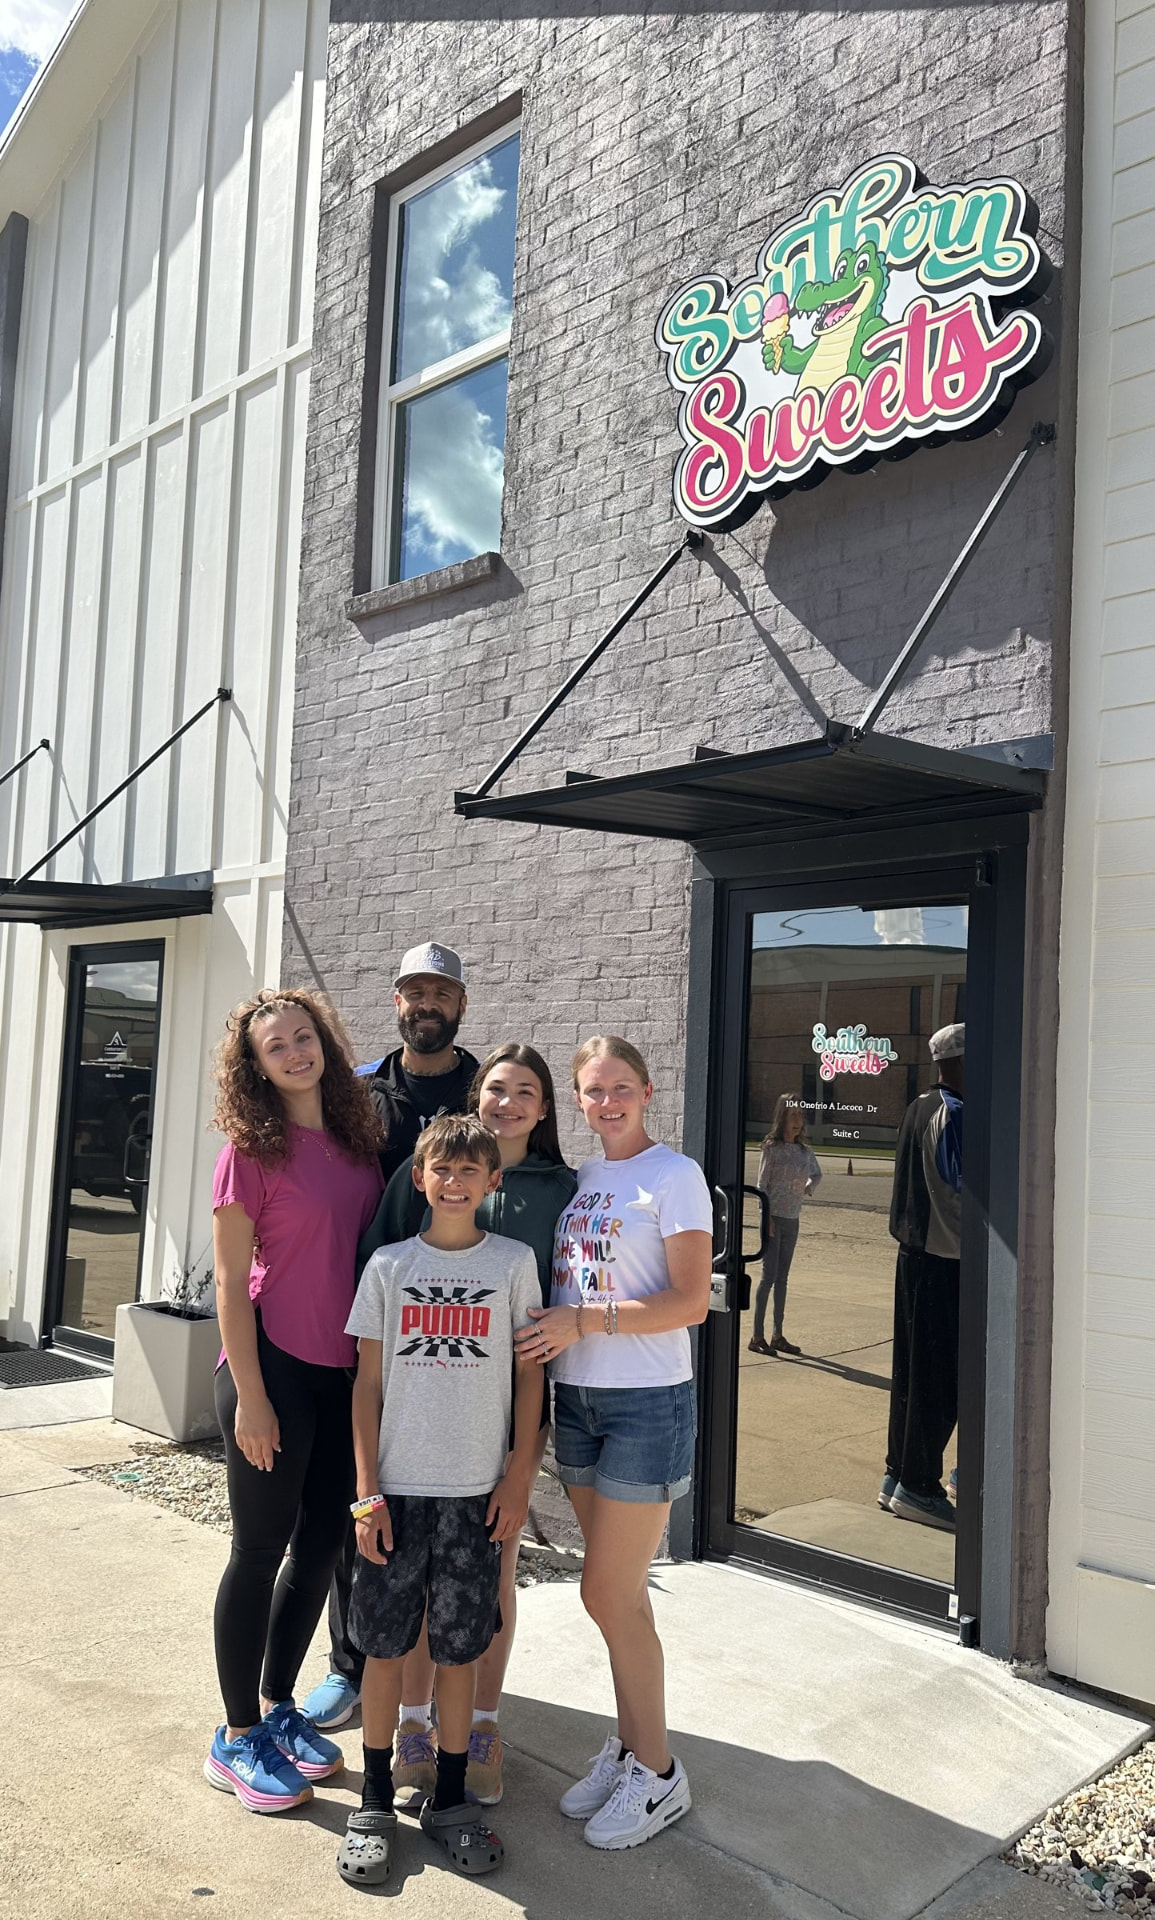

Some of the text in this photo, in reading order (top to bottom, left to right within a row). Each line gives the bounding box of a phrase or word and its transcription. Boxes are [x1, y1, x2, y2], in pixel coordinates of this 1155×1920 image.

[665, 166, 1026, 377] Southern
[683, 300, 1023, 507] Sweets
[812, 1023, 897, 1060] Southern
[820, 1052, 888, 1080] Sweets
[785, 1100, 878, 1113] 104 Onofrio A Lococo Dr
[832, 1128, 860, 1139] Suite C
[573, 1192, 615, 1211] GOD IS
[591, 1213, 623, 1238] HER
[554, 1237, 616, 1264] SHE WILL
[581, 1267, 616, 1292] FALL
[401, 1305, 491, 1337] PUMA
[231, 1756, 257, 1783] HOKA
